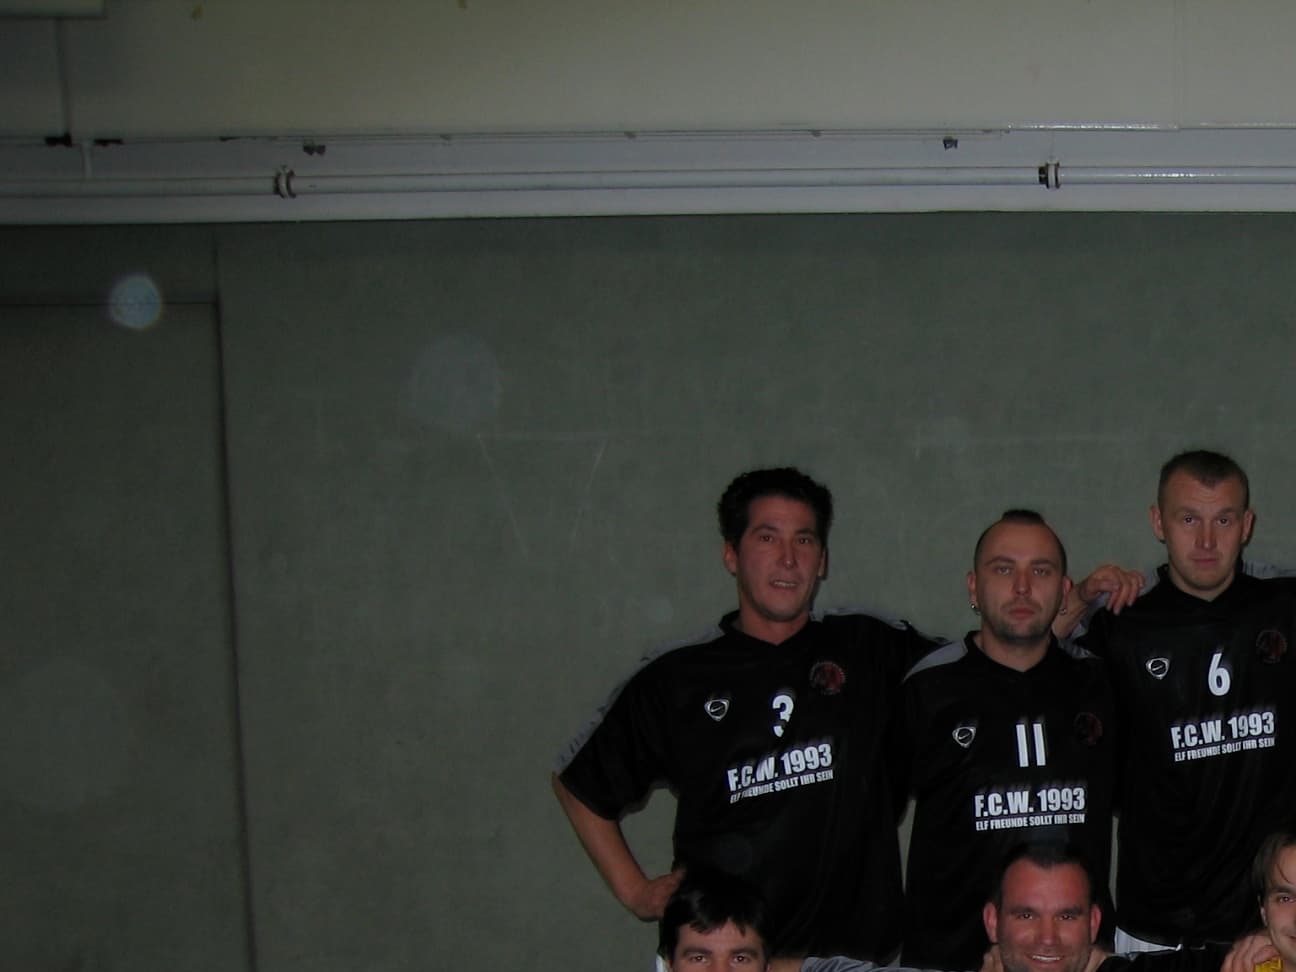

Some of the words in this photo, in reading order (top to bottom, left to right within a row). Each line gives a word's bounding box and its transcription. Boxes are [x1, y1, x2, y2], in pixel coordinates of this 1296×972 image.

[1208, 653, 1231, 696] 6
[1015, 723, 1046, 767] 11
[1171, 720, 1225, 749] F.C.W.
[1227, 712, 1275, 739] 1993
[780, 743, 832, 775] 1993
[774, 776, 799, 792] SOLLT
[974, 791, 1034, 817] F.C.W.
[1036, 787, 1085, 812] 1993
[976, 820, 989, 831] ELF
[990, 817, 1028, 830] FREUNDE
[1029, 815, 1053, 827] SOLLT
